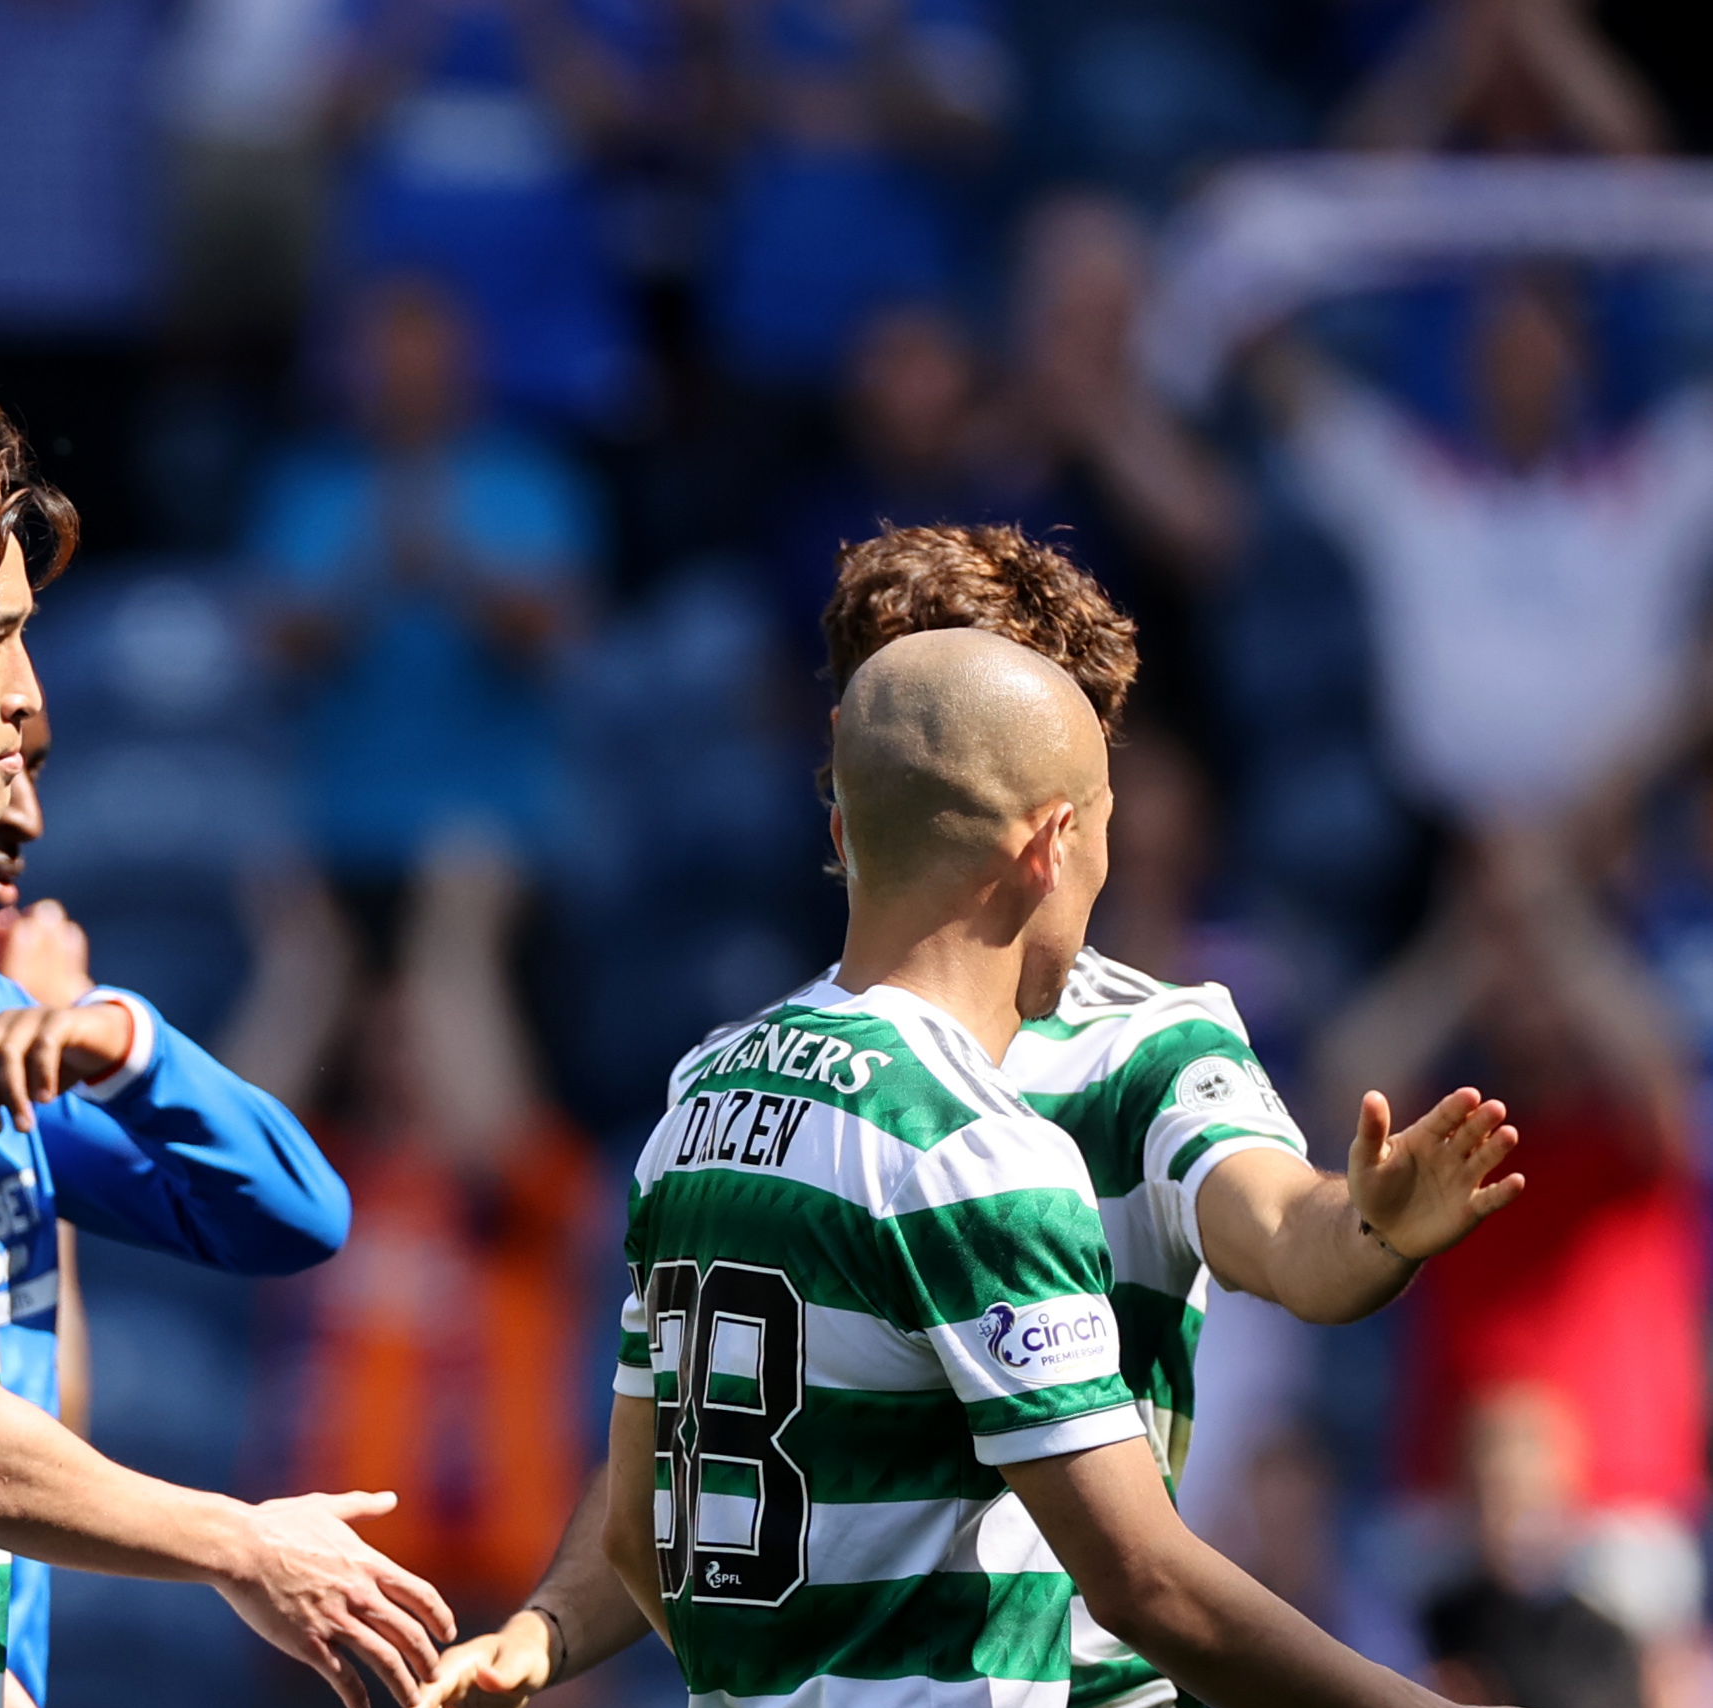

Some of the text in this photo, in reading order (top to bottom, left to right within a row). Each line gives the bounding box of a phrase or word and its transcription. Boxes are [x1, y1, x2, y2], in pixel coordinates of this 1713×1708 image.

[1022, 1311, 1107, 1352] cinch
[1041, 1345, 1105, 1367] PREMIERSHIP
[645, 1259, 811, 1608] 38
[714, 1573, 742, 1585] SPFL
